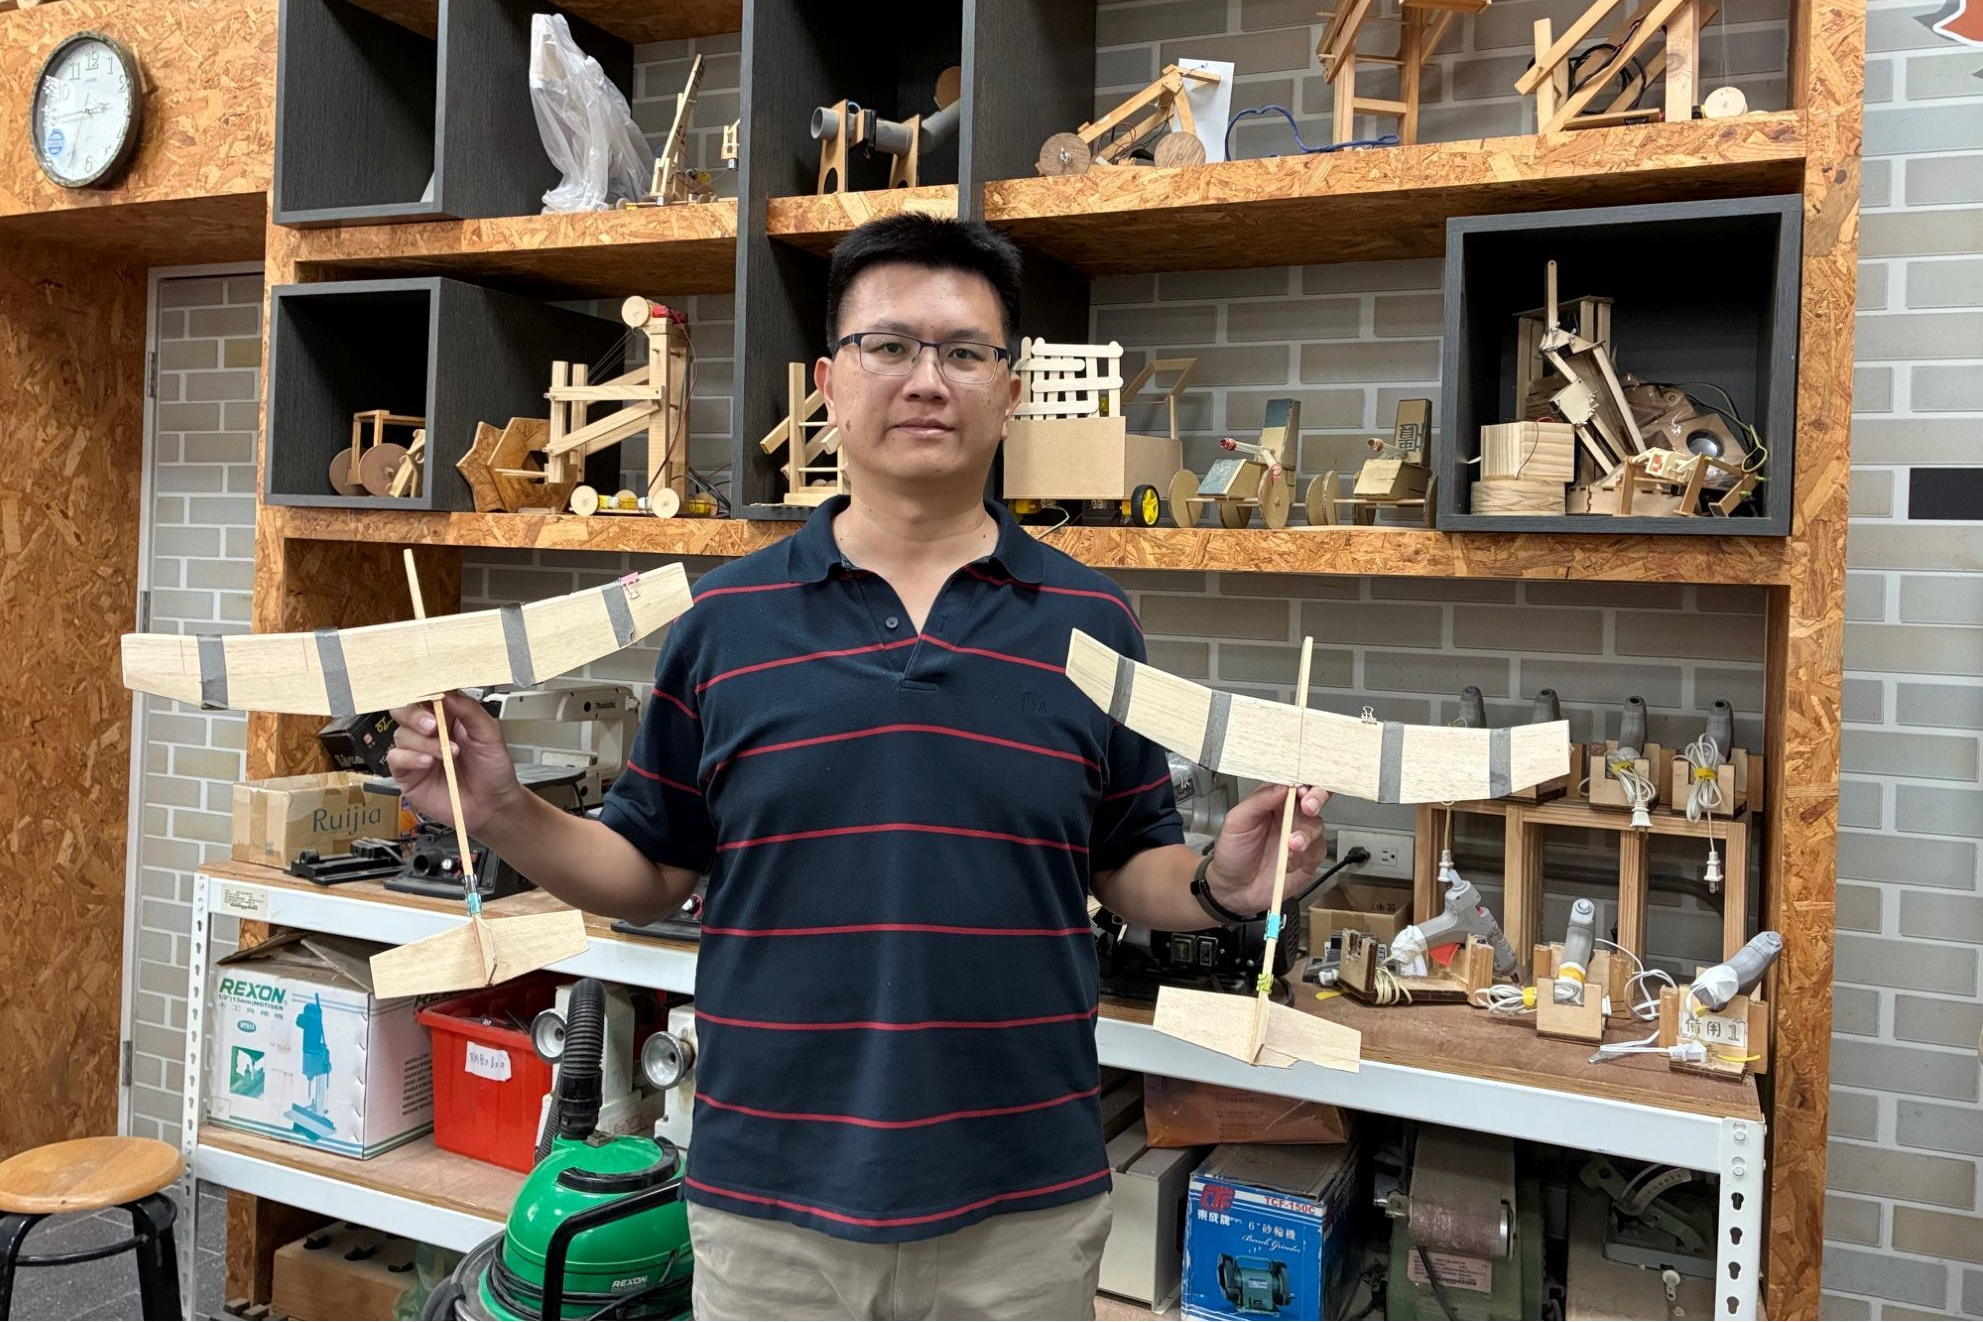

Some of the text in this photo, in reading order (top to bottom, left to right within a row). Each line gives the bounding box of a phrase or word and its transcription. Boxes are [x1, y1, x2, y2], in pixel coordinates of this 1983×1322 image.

[85, 51, 99, 71] 12
[107, 56, 114, 75] 1
[69, 62, 81, 81] 11
[85, 155, 93, 173] 6
[312, 805, 382, 835] Ruijia
[219, 978, 286, 1004] REXON
[1264, 1196, 1316, 1214] TCF-150C
[612, 1275, 648, 1287] REXON
